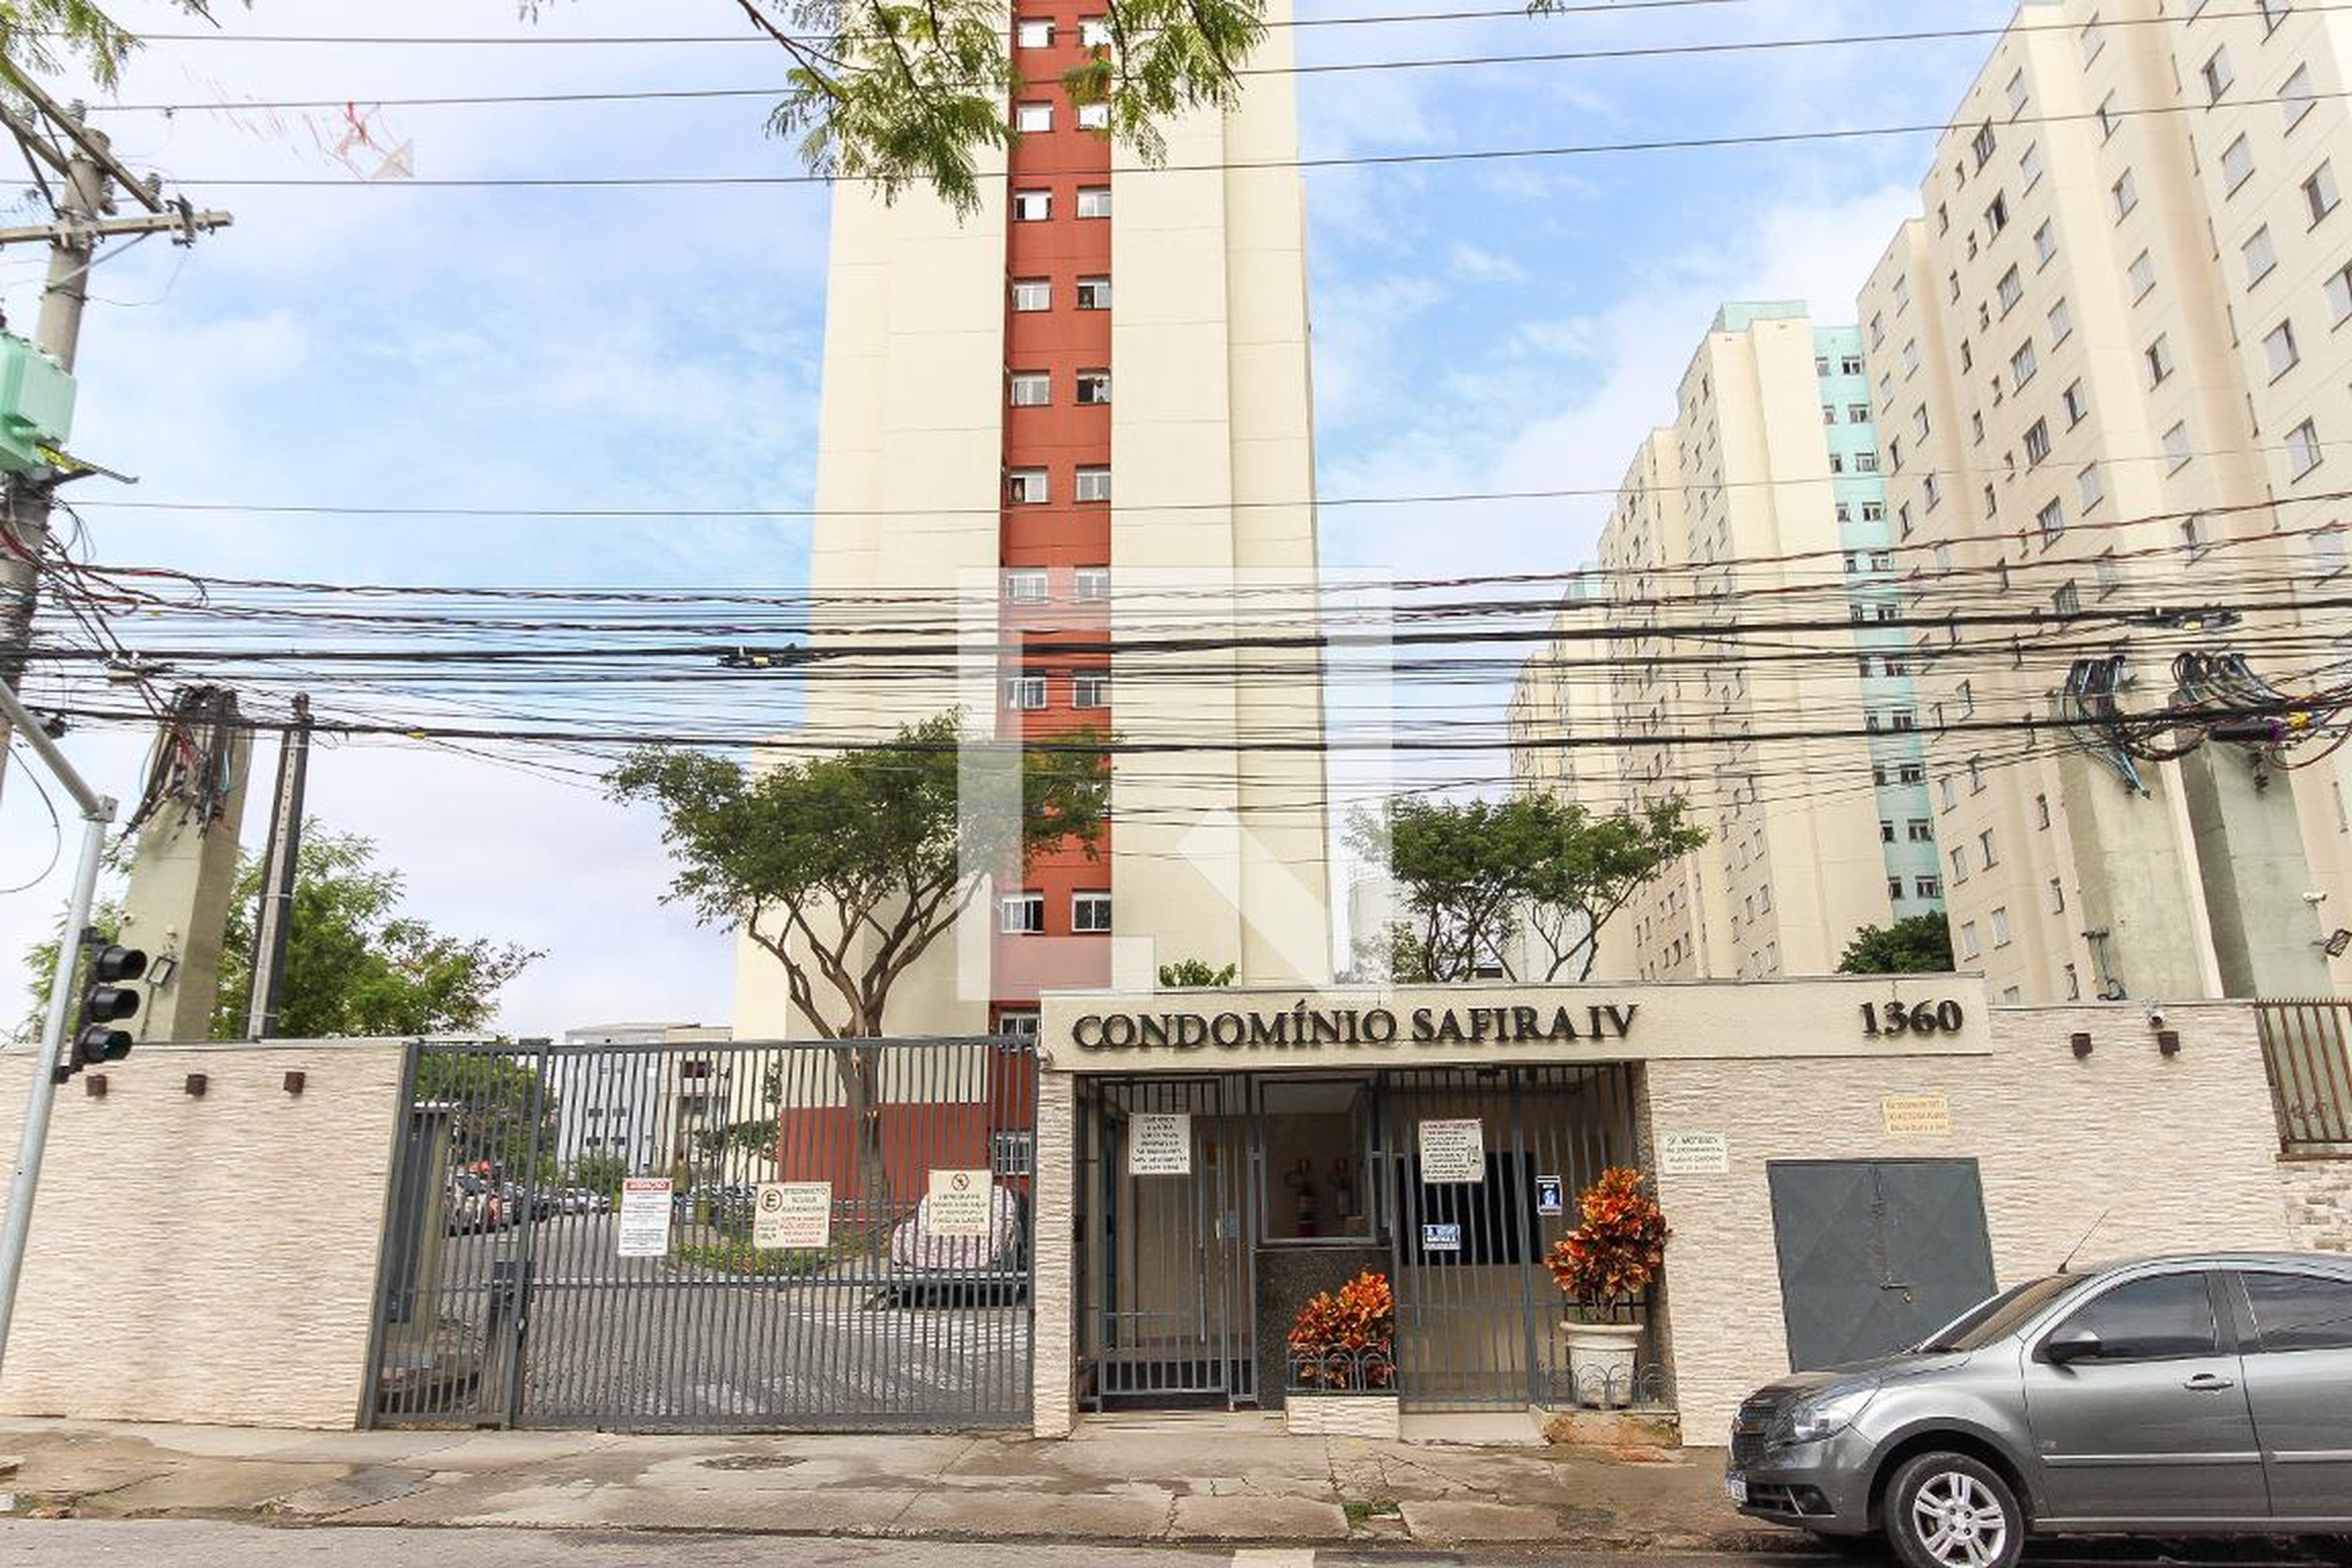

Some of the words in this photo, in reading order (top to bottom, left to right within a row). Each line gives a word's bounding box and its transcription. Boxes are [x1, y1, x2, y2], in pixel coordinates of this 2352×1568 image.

[1072, 998, 1397, 1048] CONDOMÍNIO
[1412, 1006, 1578, 1042] SAFIRA
[1587, 1004, 1639, 1039] IV
[1860, 1000, 1963, 1035] 1360
[766, 1193, 777, 1207] E
